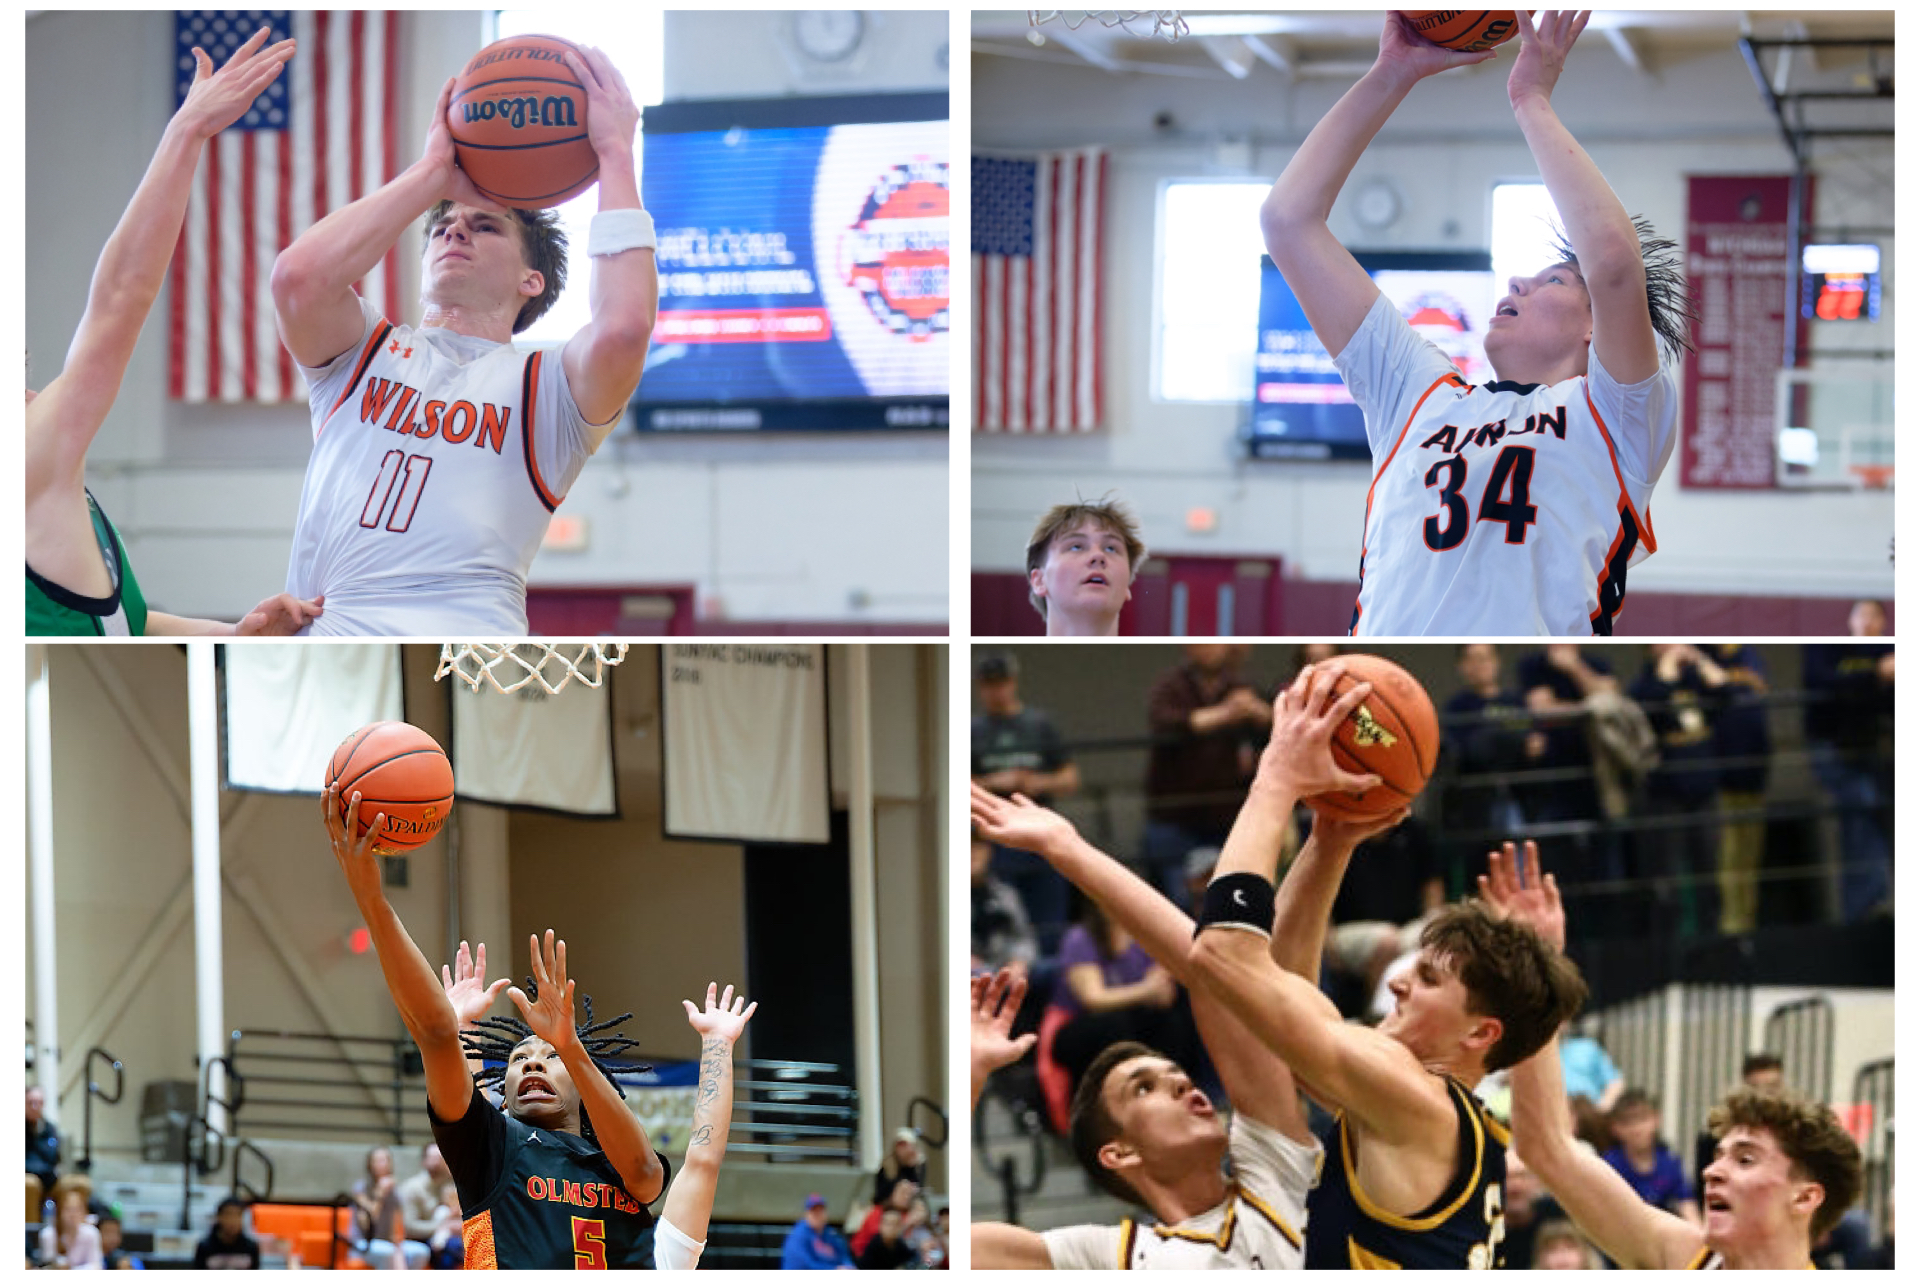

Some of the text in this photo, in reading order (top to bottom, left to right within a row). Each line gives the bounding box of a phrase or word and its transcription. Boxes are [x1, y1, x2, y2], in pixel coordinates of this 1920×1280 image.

[466, 46, 568, 76] VOLUTION
[461, 95, 578, 129] Wilson
[361, 376, 512, 455] WILSON
[359, 448, 433, 533] 11
[1423, 444, 1538, 552] 34
[571, 1215, 607, 1269] 5
